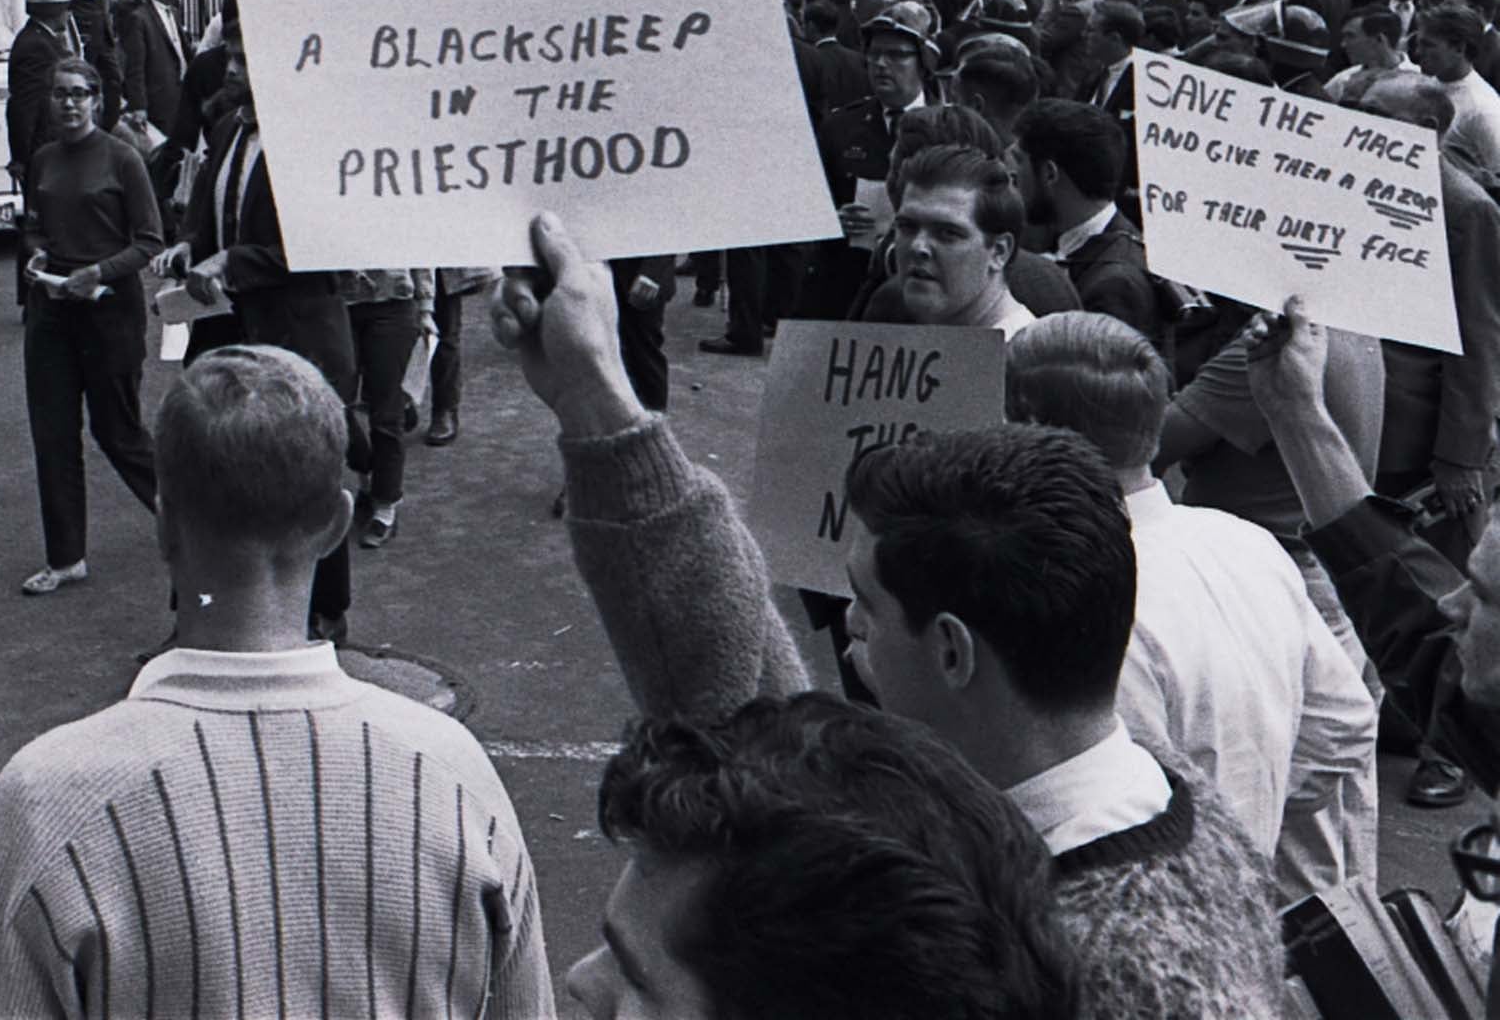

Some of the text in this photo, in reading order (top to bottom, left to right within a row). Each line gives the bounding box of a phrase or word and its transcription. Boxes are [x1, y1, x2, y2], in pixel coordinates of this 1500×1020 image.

[295, 11, 712, 72] A BLACKSHEEP
[431, 79, 616, 120] IN THE
[1145, 61, 1426, 170] SAVE THE MACE
[339, 125, 691, 197] PRIESTHOOD
[1143, 122, 1439, 217] AND GIVE THEM A RAZOR
[1145, 183, 1431, 269] FOR THEIR DIRTY FACE
[824, 337, 941, 407] HANG
